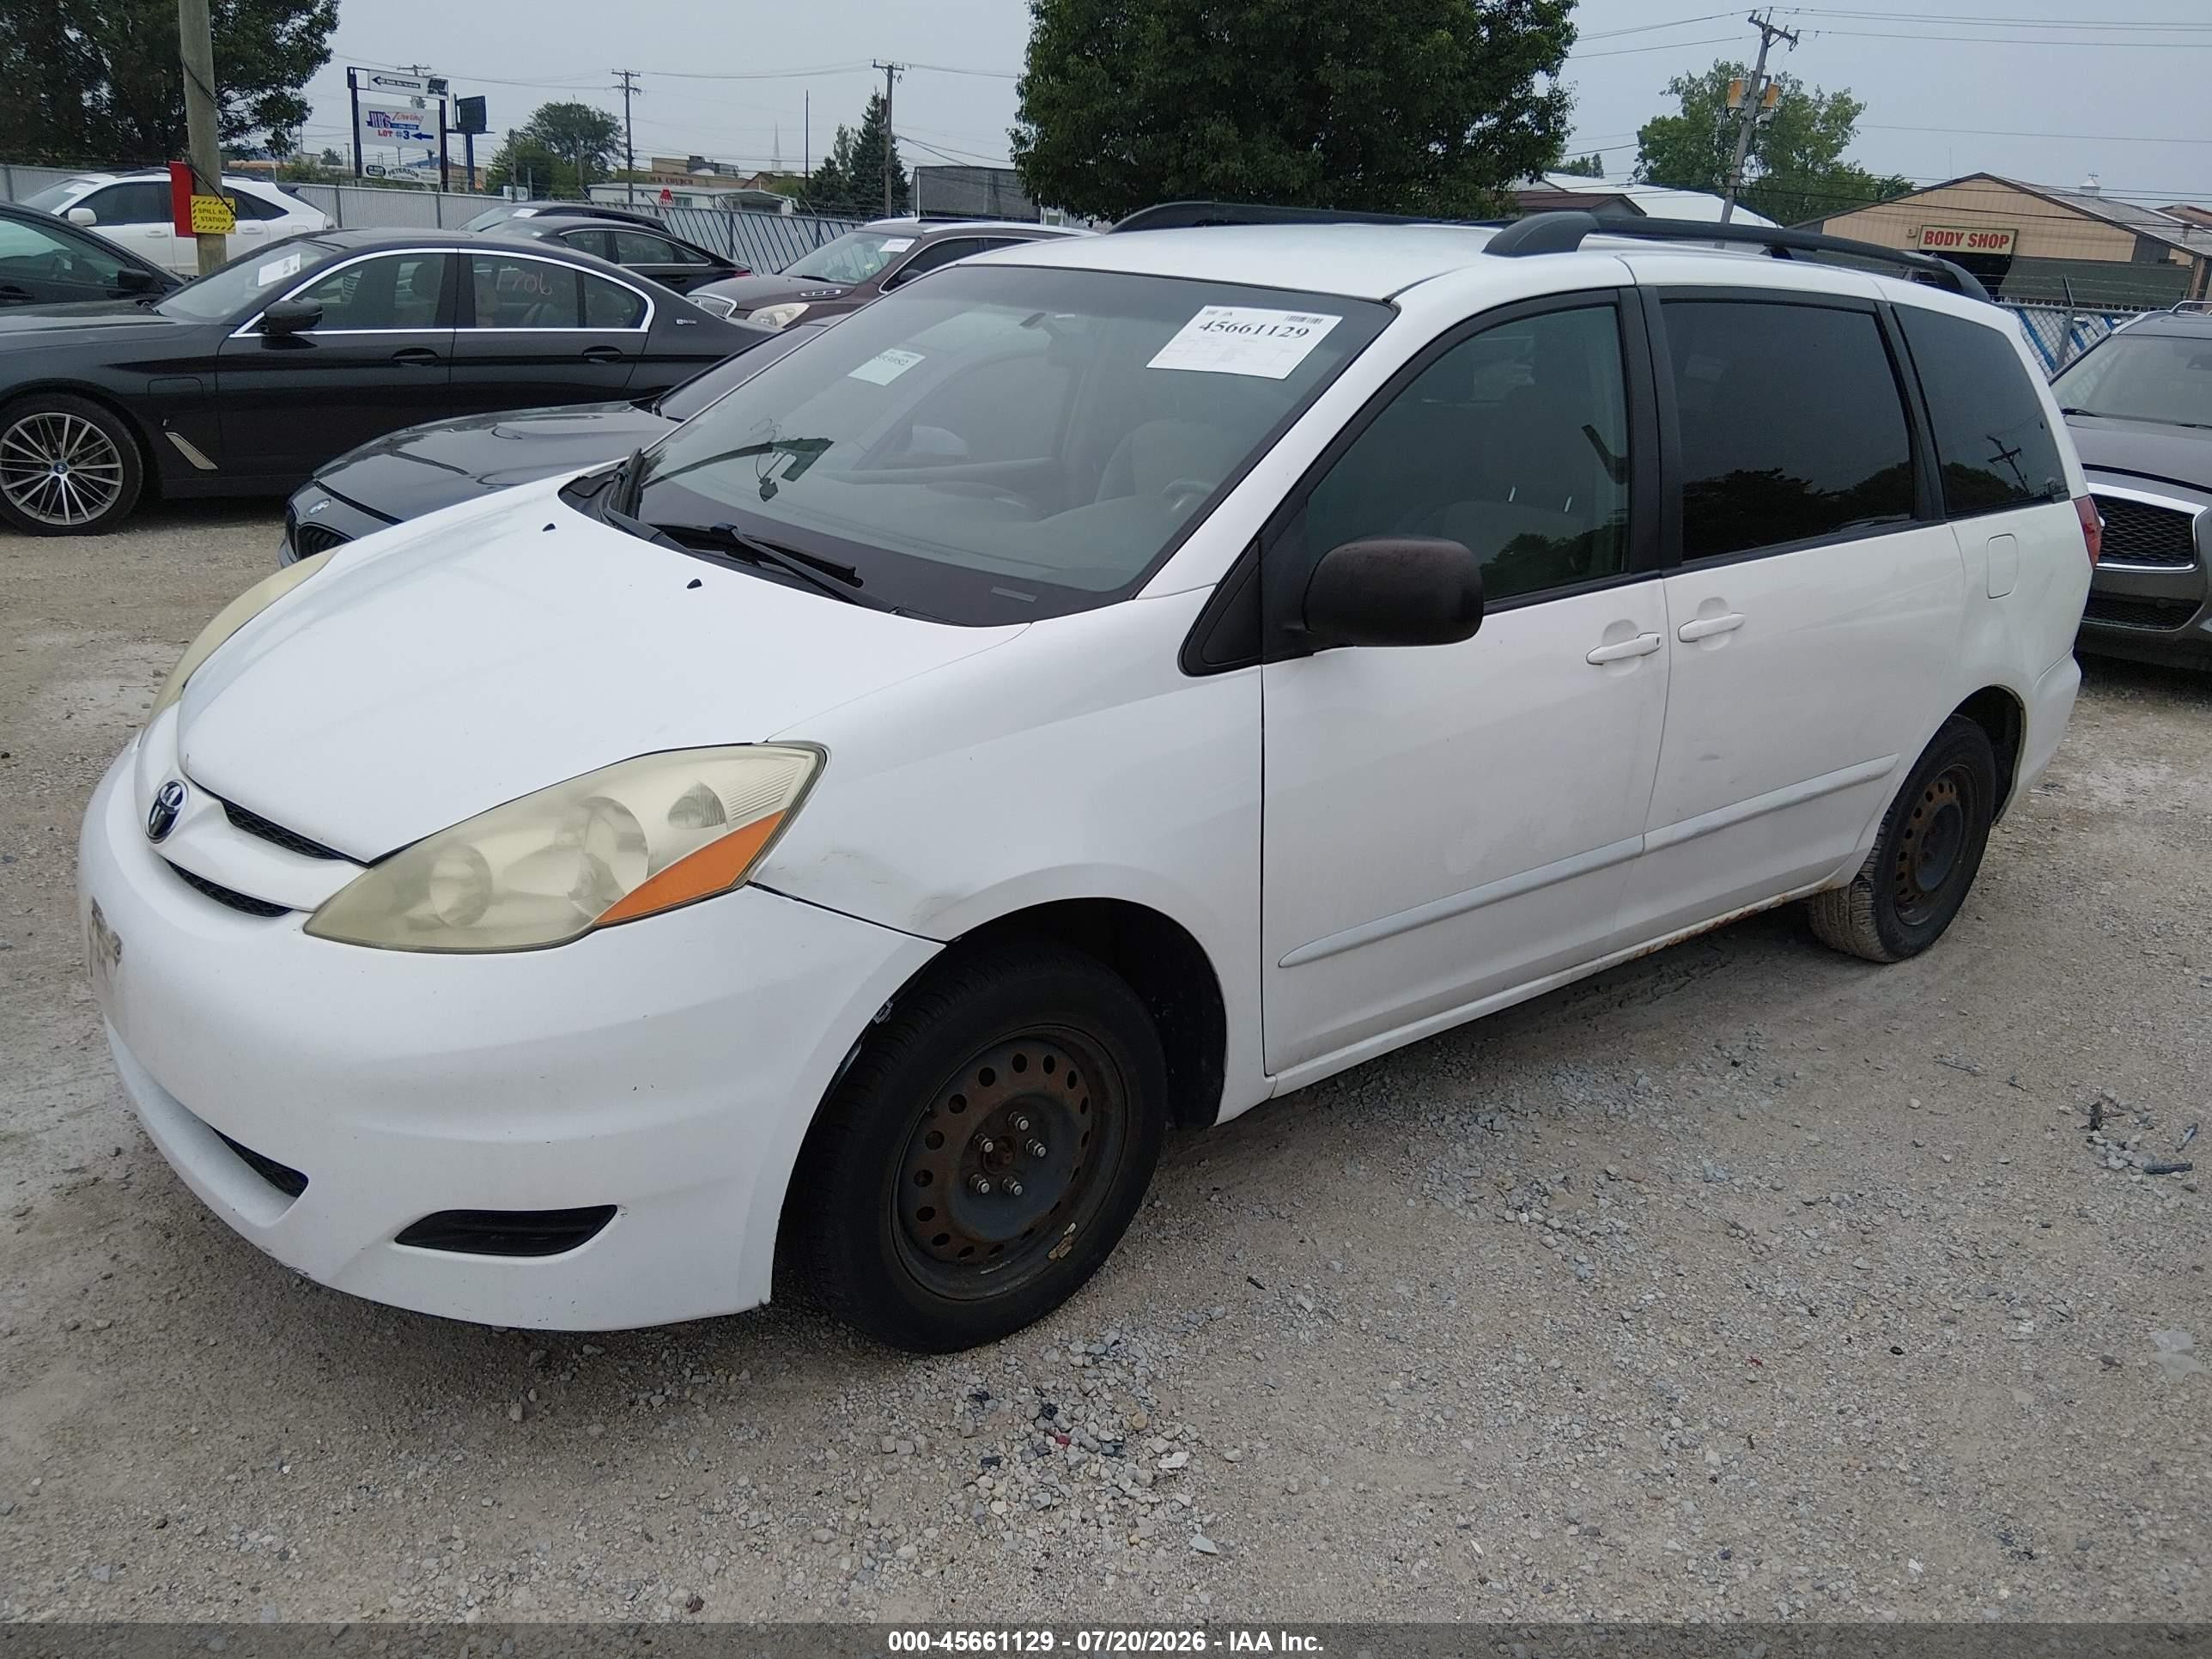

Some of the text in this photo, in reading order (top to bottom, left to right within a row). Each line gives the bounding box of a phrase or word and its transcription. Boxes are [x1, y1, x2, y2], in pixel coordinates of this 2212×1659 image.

[396, 130, 410, 140] #3
[387, 167, 420, 179] PETERSON
[1923, 231, 2009, 248] BODY SHOP
[1199, 320, 1310, 339] 45661129
